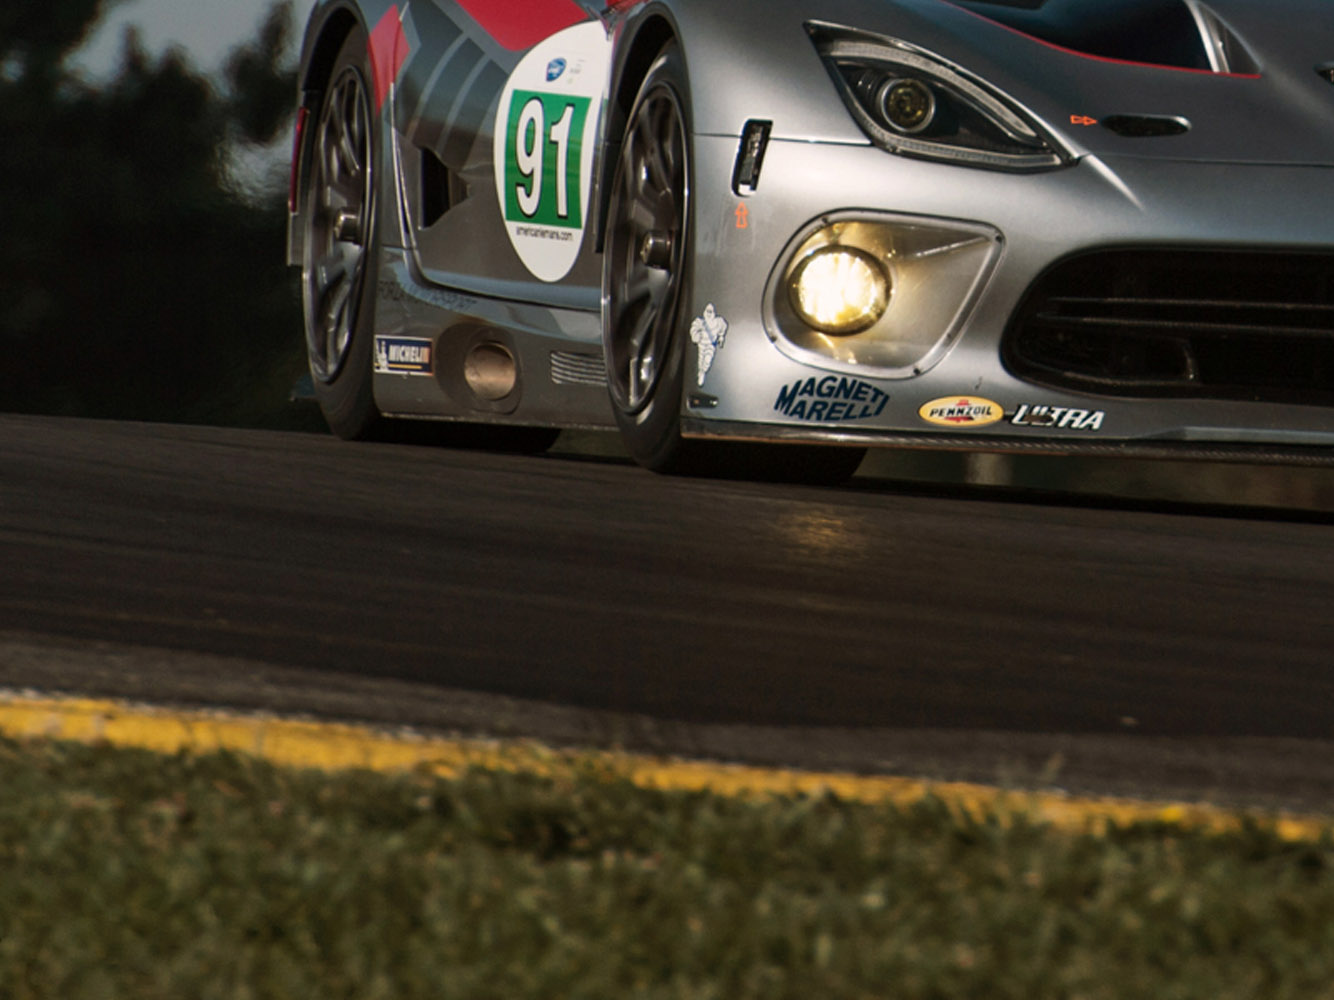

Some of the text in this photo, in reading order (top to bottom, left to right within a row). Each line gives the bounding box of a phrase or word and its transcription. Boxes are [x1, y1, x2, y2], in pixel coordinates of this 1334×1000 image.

[515, 95, 576, 220] 91
[774, 375, 890, 416] MAGNETI
[774, 396, 884, 422] MARELLI
[929, 405, 992, 419] PENNZOIL
